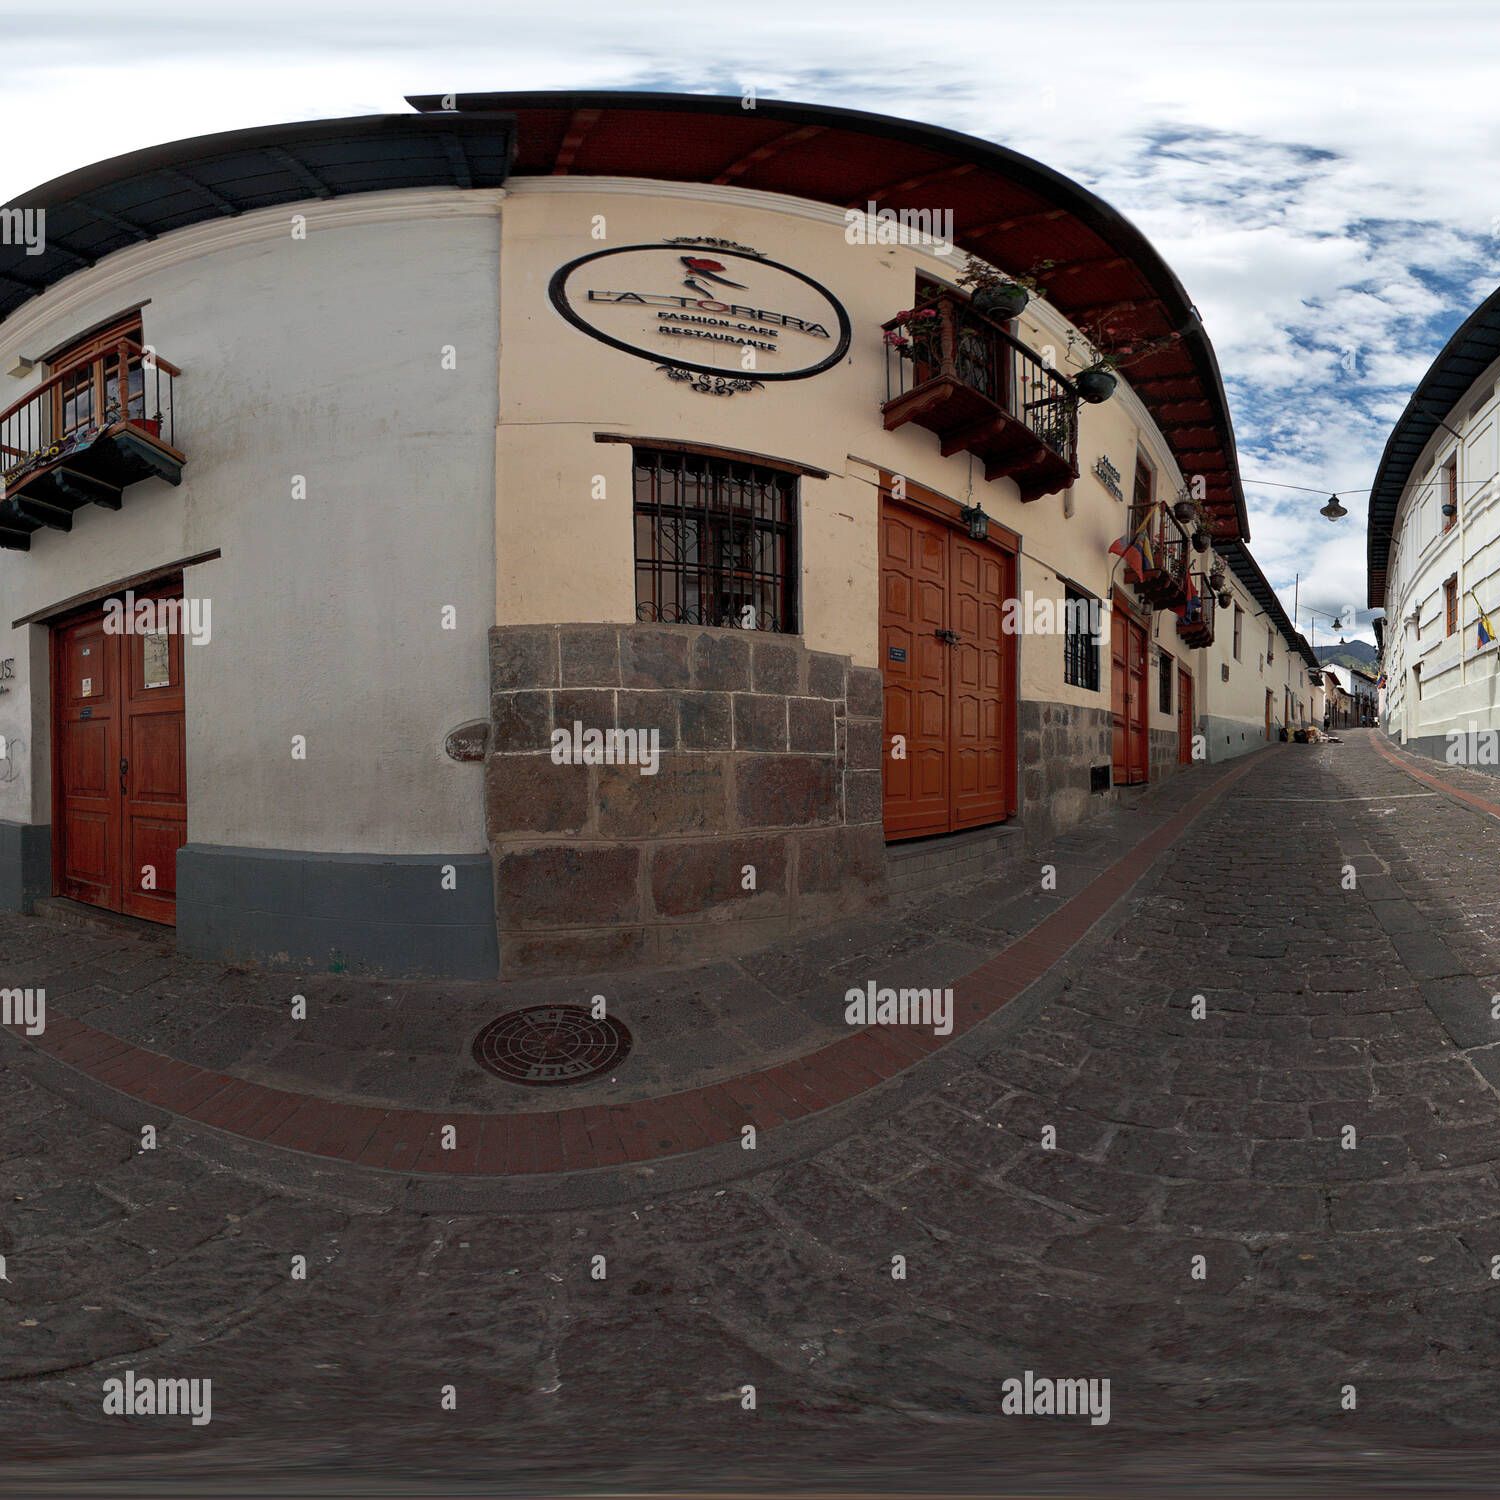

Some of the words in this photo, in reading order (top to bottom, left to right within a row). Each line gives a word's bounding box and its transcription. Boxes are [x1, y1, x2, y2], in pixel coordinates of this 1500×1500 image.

[588, 290, 647, 303] LA
[670, 295, 830, 338] TORERA
[659, 325, 777, 352] RESTAURANTE
